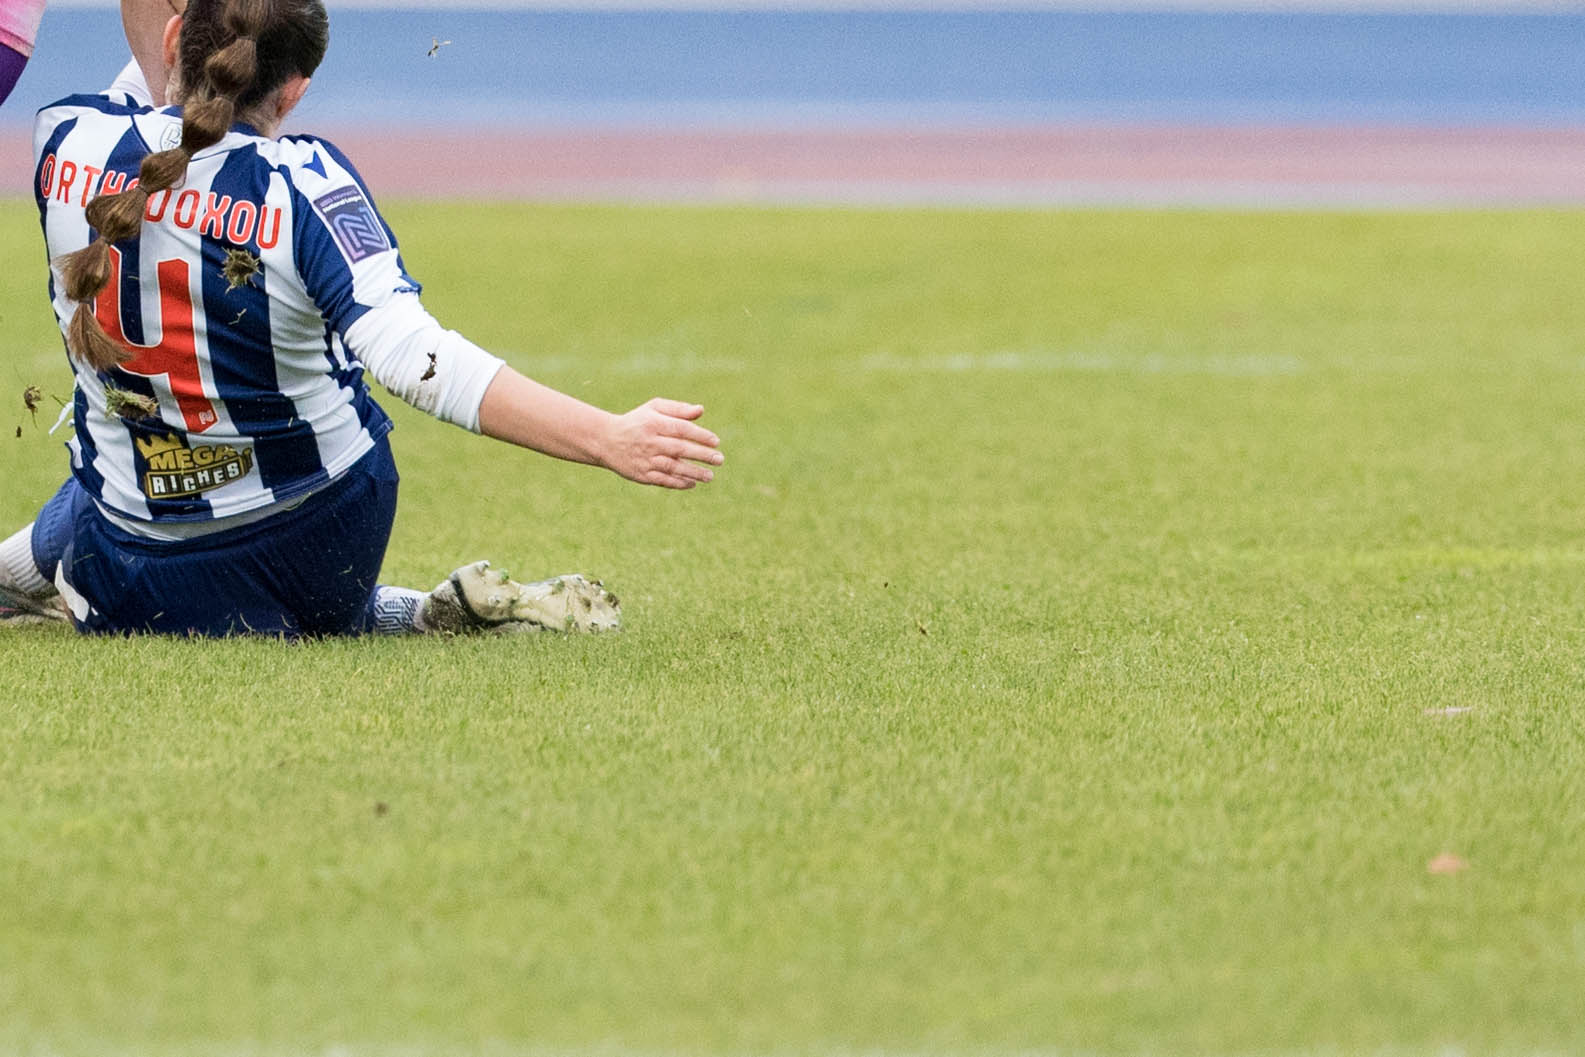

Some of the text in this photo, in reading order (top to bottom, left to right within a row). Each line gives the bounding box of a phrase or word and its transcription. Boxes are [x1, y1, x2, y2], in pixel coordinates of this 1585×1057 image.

[41, 153, 282, 249] ORTHDOXOU
[92, 244, 219, 434] 4
[149, 444, 237, 471] MEGA
[151, 462, 240, 494] RICHES
